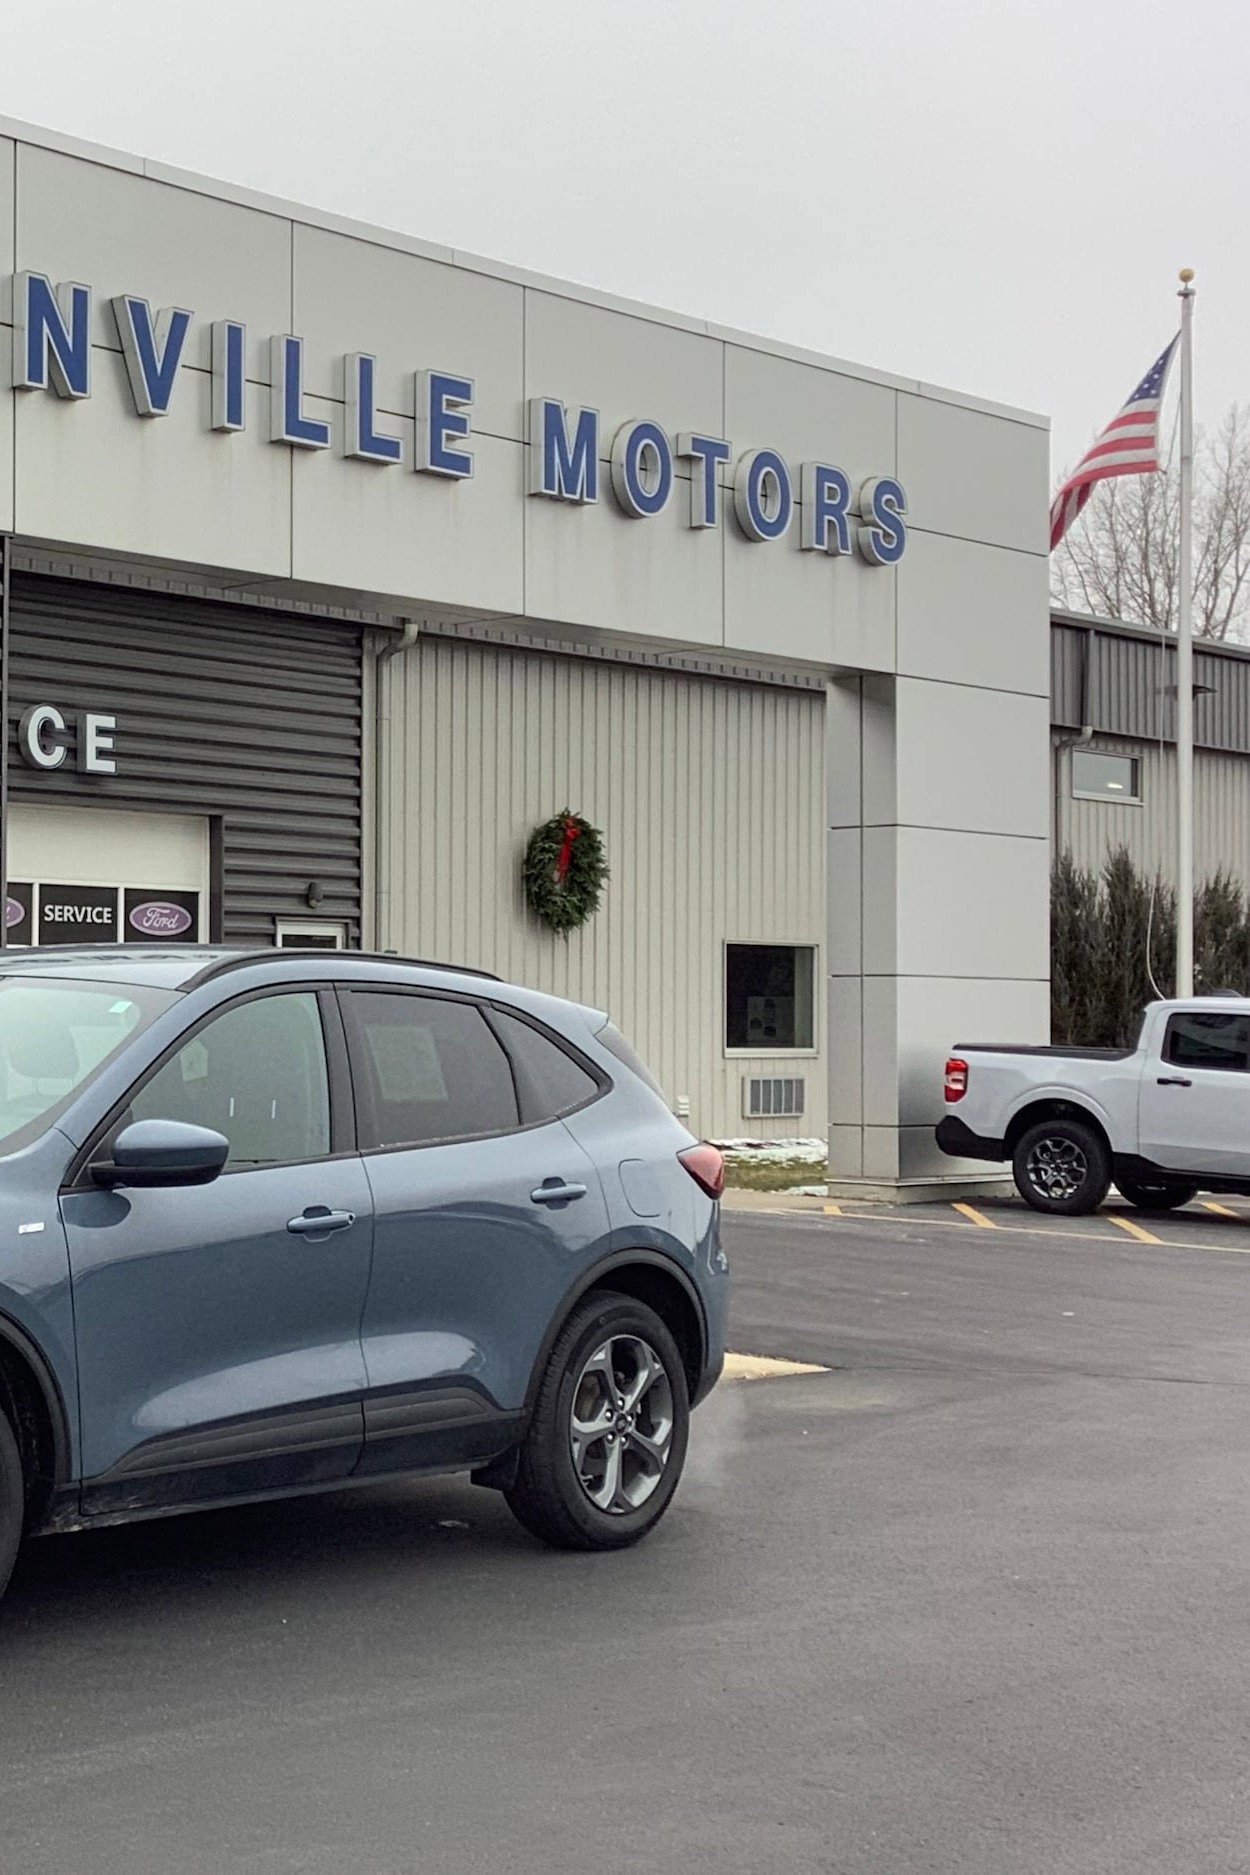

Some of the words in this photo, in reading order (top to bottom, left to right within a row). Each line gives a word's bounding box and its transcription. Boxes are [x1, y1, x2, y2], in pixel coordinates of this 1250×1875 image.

[529, 396, 908, 566] MOTORS
[44, 905, 113, 924] SERVICE
[142, 907, 180, 929] Ford
